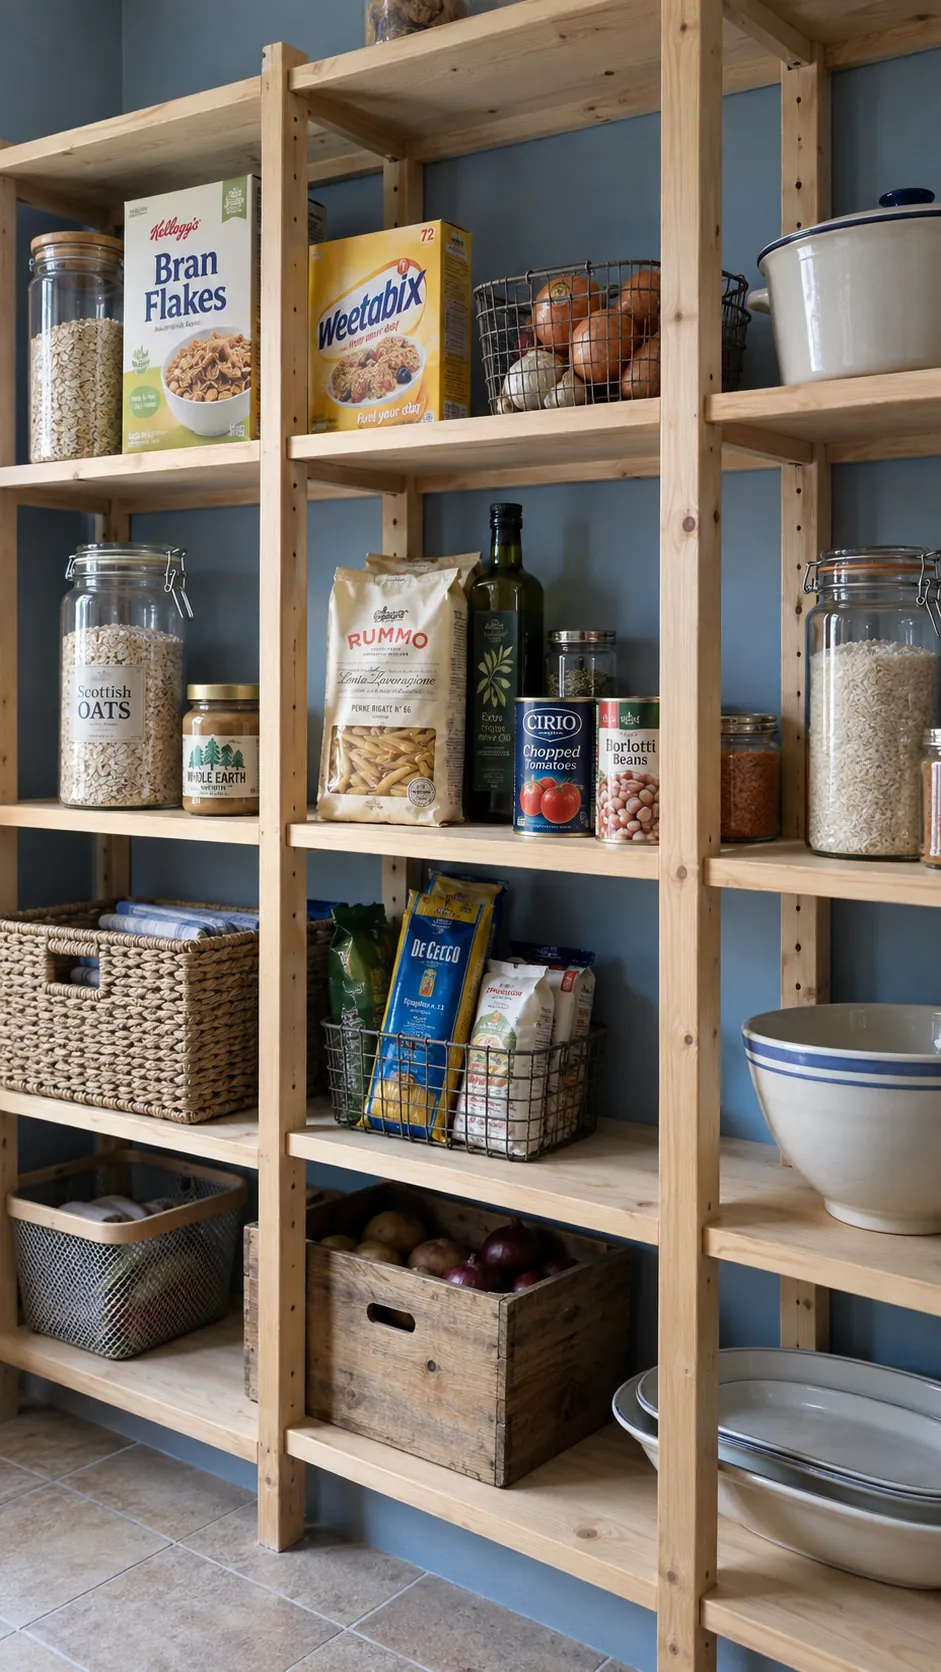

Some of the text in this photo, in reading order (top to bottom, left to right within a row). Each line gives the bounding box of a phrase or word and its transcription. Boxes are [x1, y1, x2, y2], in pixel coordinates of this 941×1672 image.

[150, 216, 200, 241] Kellogg's
[421, 228, 435, 242] 72
[154, 250, 218, 285] Bran
[144, 285, 227, 323] Flakes
[318, 268, 427, 350] Weetabix
[378, 408, 400, 425] your
[347, 627, 429, 650] RUMMO
[78, 685, 132, 698] Scottish
[78, 701, 131, 720] OATS
[527, 715, 576, 731] CIRIO
[523, 744, 581, 760] Chopped
[606, 738, 656, 753] Borlotti
[525, 759, 577, 771] Tomatoes
[613, 753, 648, 766] Beans
[215, 771, 246, 784] EARTH
[411, 938, 461, 964] DE CECCO
